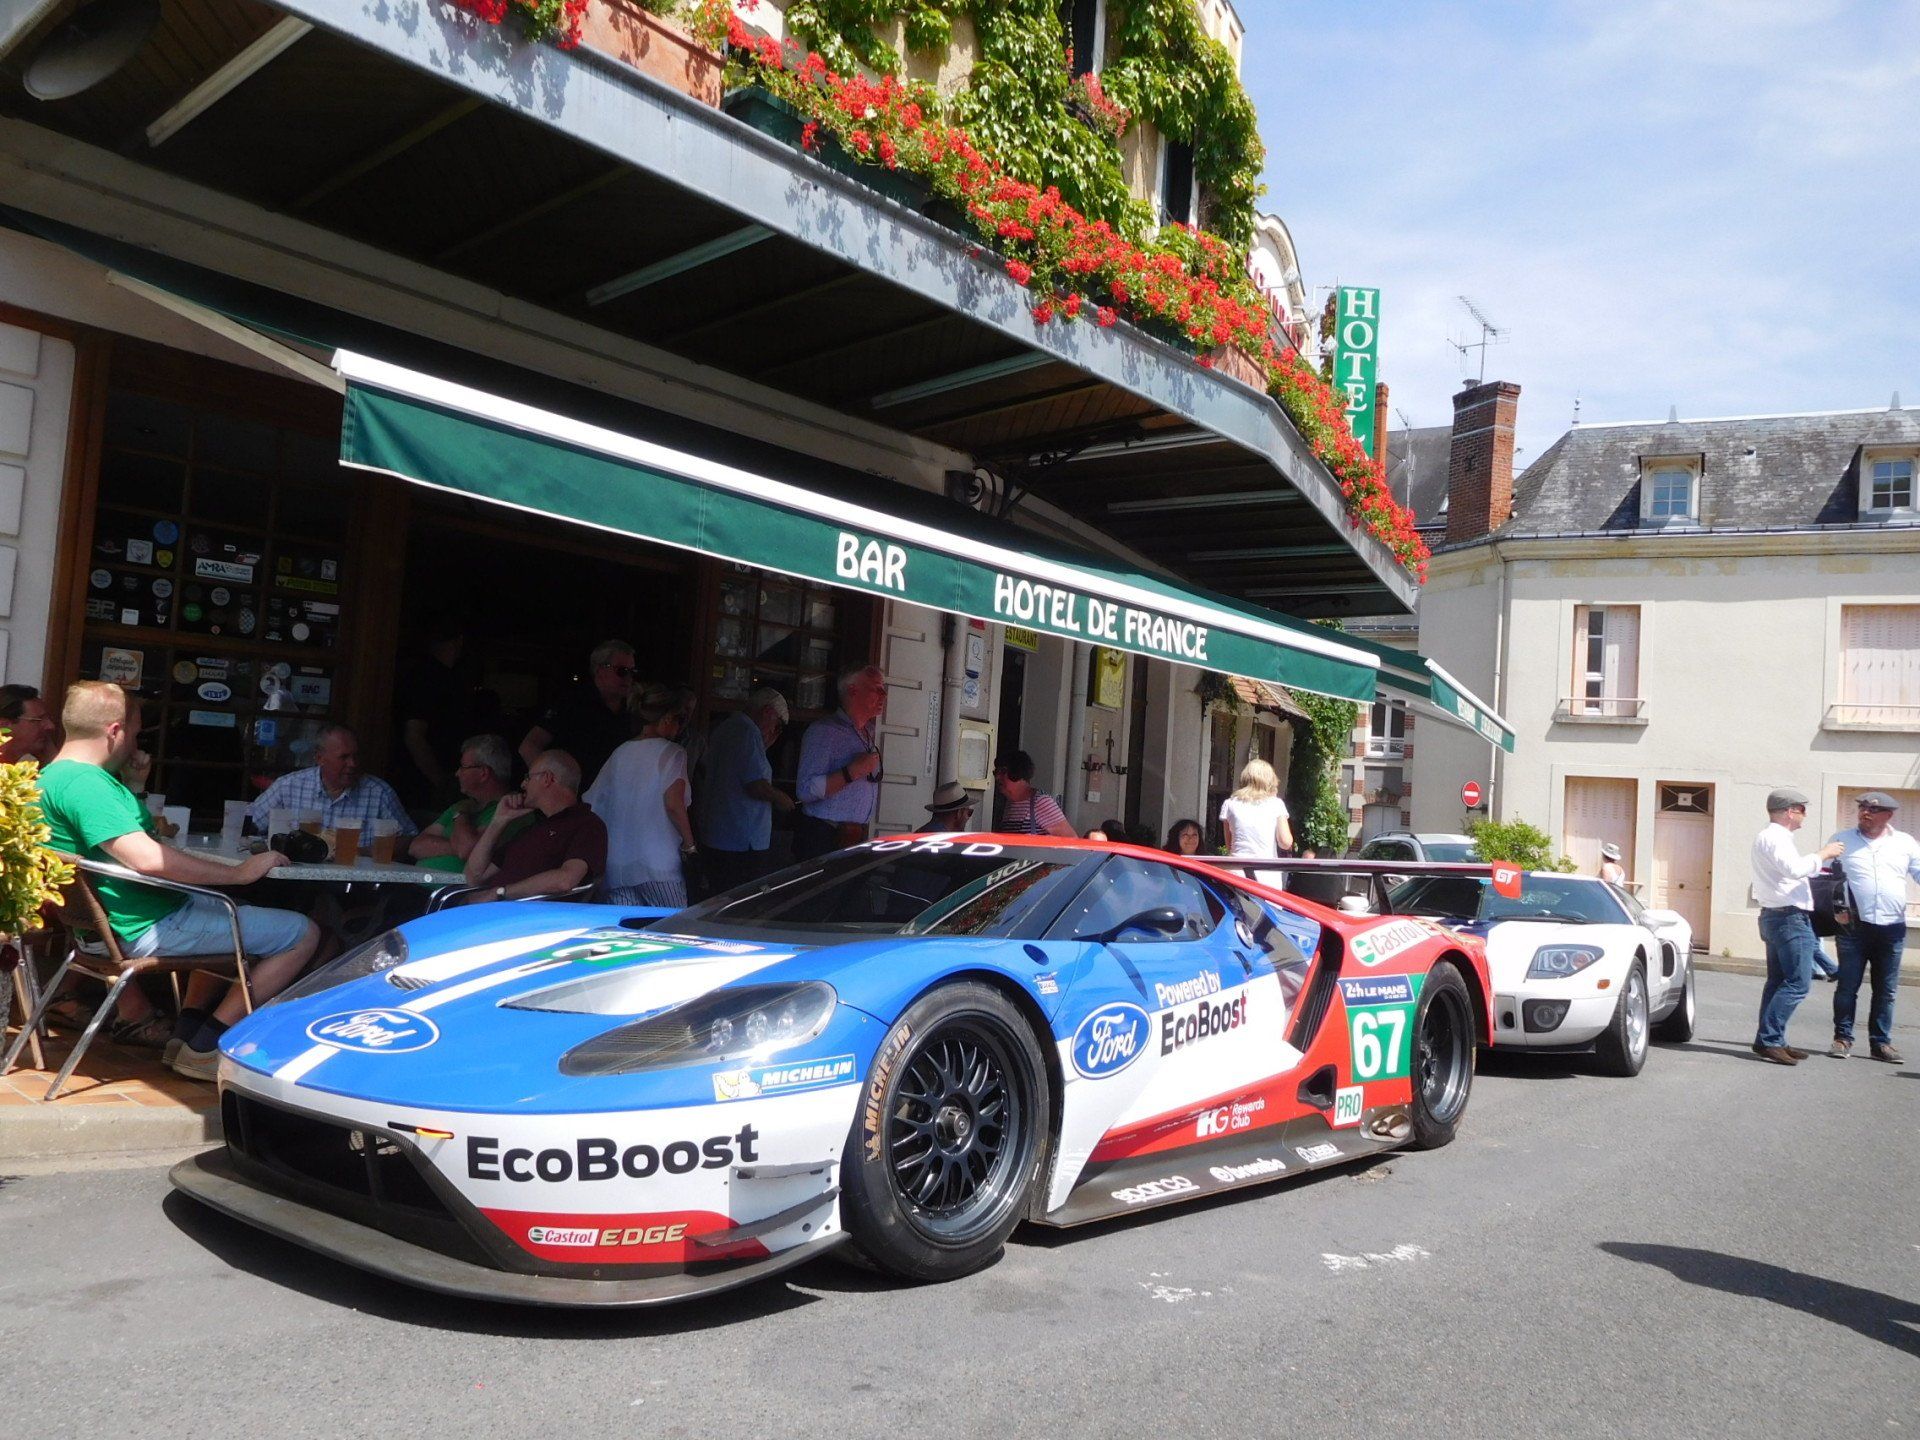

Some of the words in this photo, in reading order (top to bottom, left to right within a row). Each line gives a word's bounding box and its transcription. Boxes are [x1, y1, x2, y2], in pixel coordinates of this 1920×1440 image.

[836, 532, 907, 591] BAR
[994, 574, 1080, 631] HOTEL
[1088, 598, 1118, 640] DE
[1124, 611, 1208, 661] FRANCE
[1006, 625, 1038, 649] ESTAURANT
[845, 840, 1004, 857] FORD
[1494, 868, 1518, 885] GT
[1369, 921, 1421, 956] Castrol
[1155, 970, 1208, 1008] Powered
[1204, 969, 1221, 993] by
[1364, 986, 1377, 997] LE
[1377, 984, 1408, 996] MANS
[319, 1011, 417, 1047] Ford
[1160, 989, 1247, 1057] EcoBoost
[1087, 1012, 1138, 1069] Ford
[1352, 1009, 1406, 1078] 67
[761, 1060, 853, 1086] MICHELIN
[1232, 1097, 1266, 1116] Rewards
[1336, 1092, 1361, 1119] PRO
[1231, 1114, 1251, 1129] Club
[466, 1123, 759, 1182] EcoBoost
[545, 1229, 594, 1245] Castrol
[599, 1222, 689, 1246] EDGE
